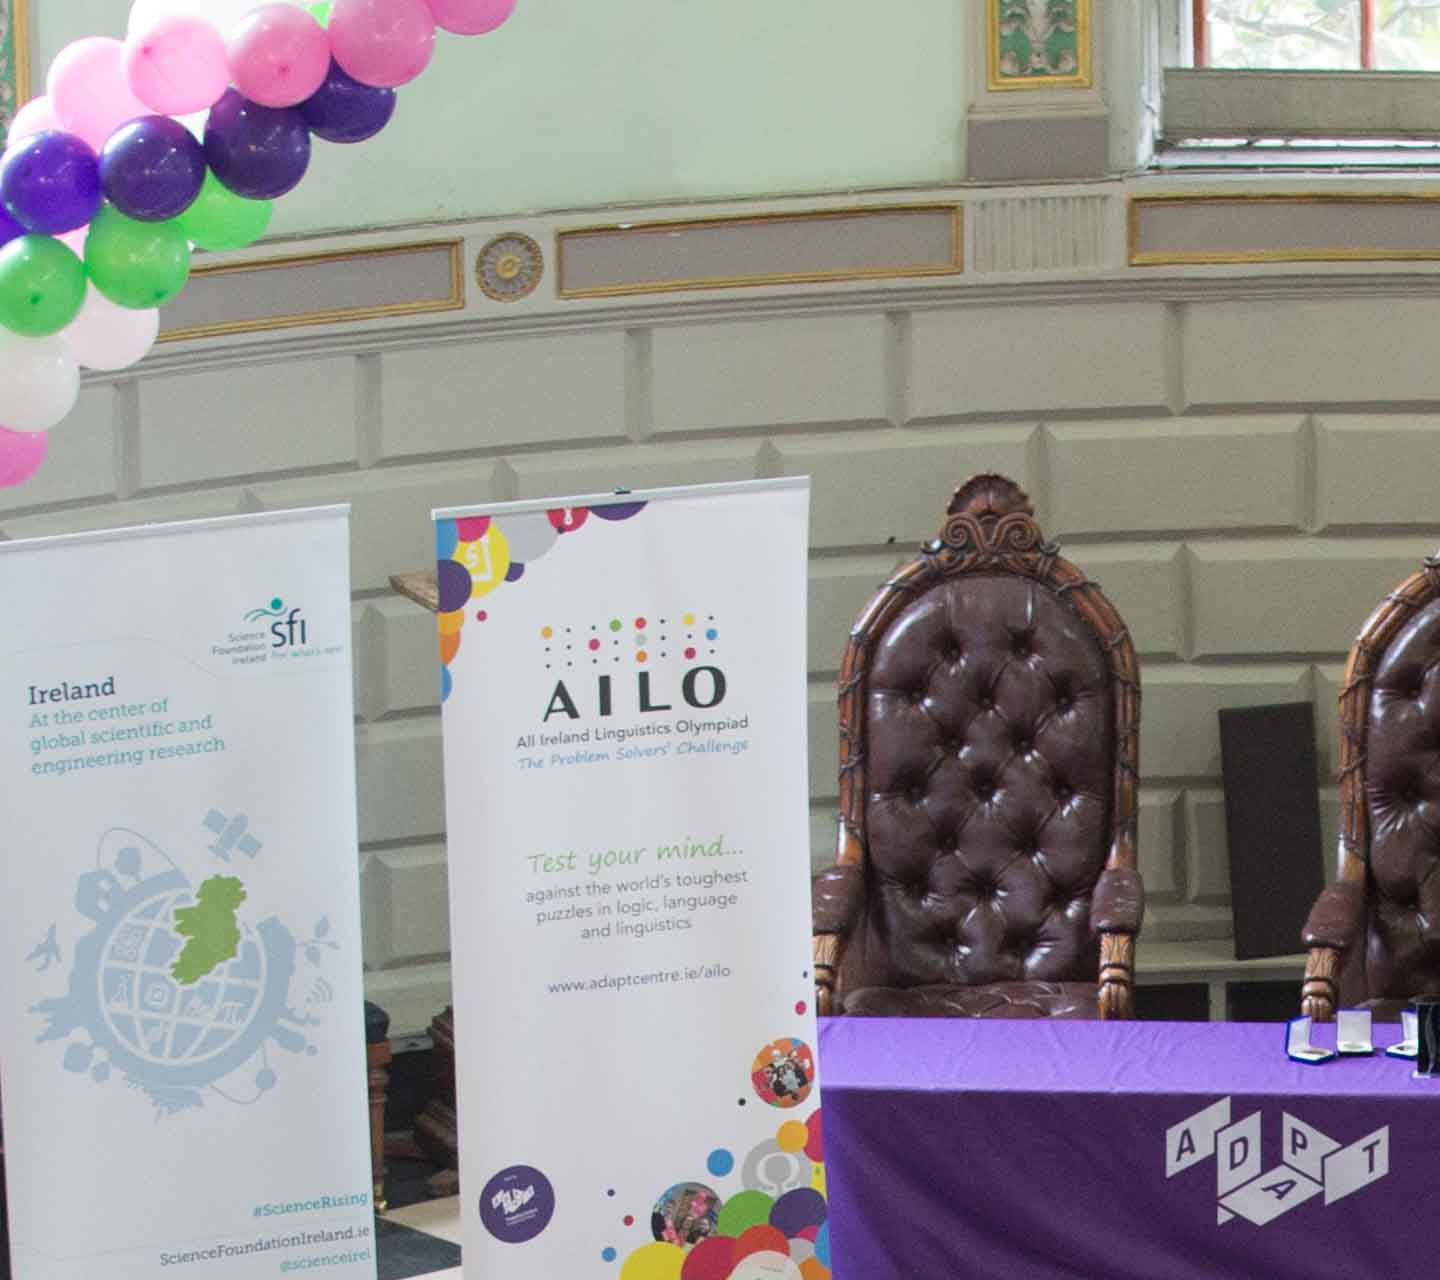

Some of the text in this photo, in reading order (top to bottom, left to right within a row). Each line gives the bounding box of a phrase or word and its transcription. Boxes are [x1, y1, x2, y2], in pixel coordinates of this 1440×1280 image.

[228, 630, 266, 643] Science
[270, 608, 306, 648] sfi
[211, 643, 267, 657] Foundation
[28, 676, 116, 705] Ireland
[543, 664, 727, 723] AILO
[29, 697, 169, 728] At the center of
[30, 715, 212, 754] global scientific and
[516, 714, 749, 749] All Ireland Linguistics Olympiad
[31, 737, 225, 776] engineering research
[518, 737, 750, 771] The Problem Solvers' Challenge
[526, 834, 744, 875] Test your mind...
[525, 869, 750, 906] against the world's toughest
[535, 891, 739, 926] puzzles in logic, language
[580, 916, 693, 940] and linguistics
[547, 963, 732, 994] www.adaptcentre.ie/ailo
[253, 1192, 368, 1219] #ScienceRising
[159, 1224, 370, 1267] ScienceFoundationIreland.ie
[279, 1248, 371, 1273] @scienceirel
